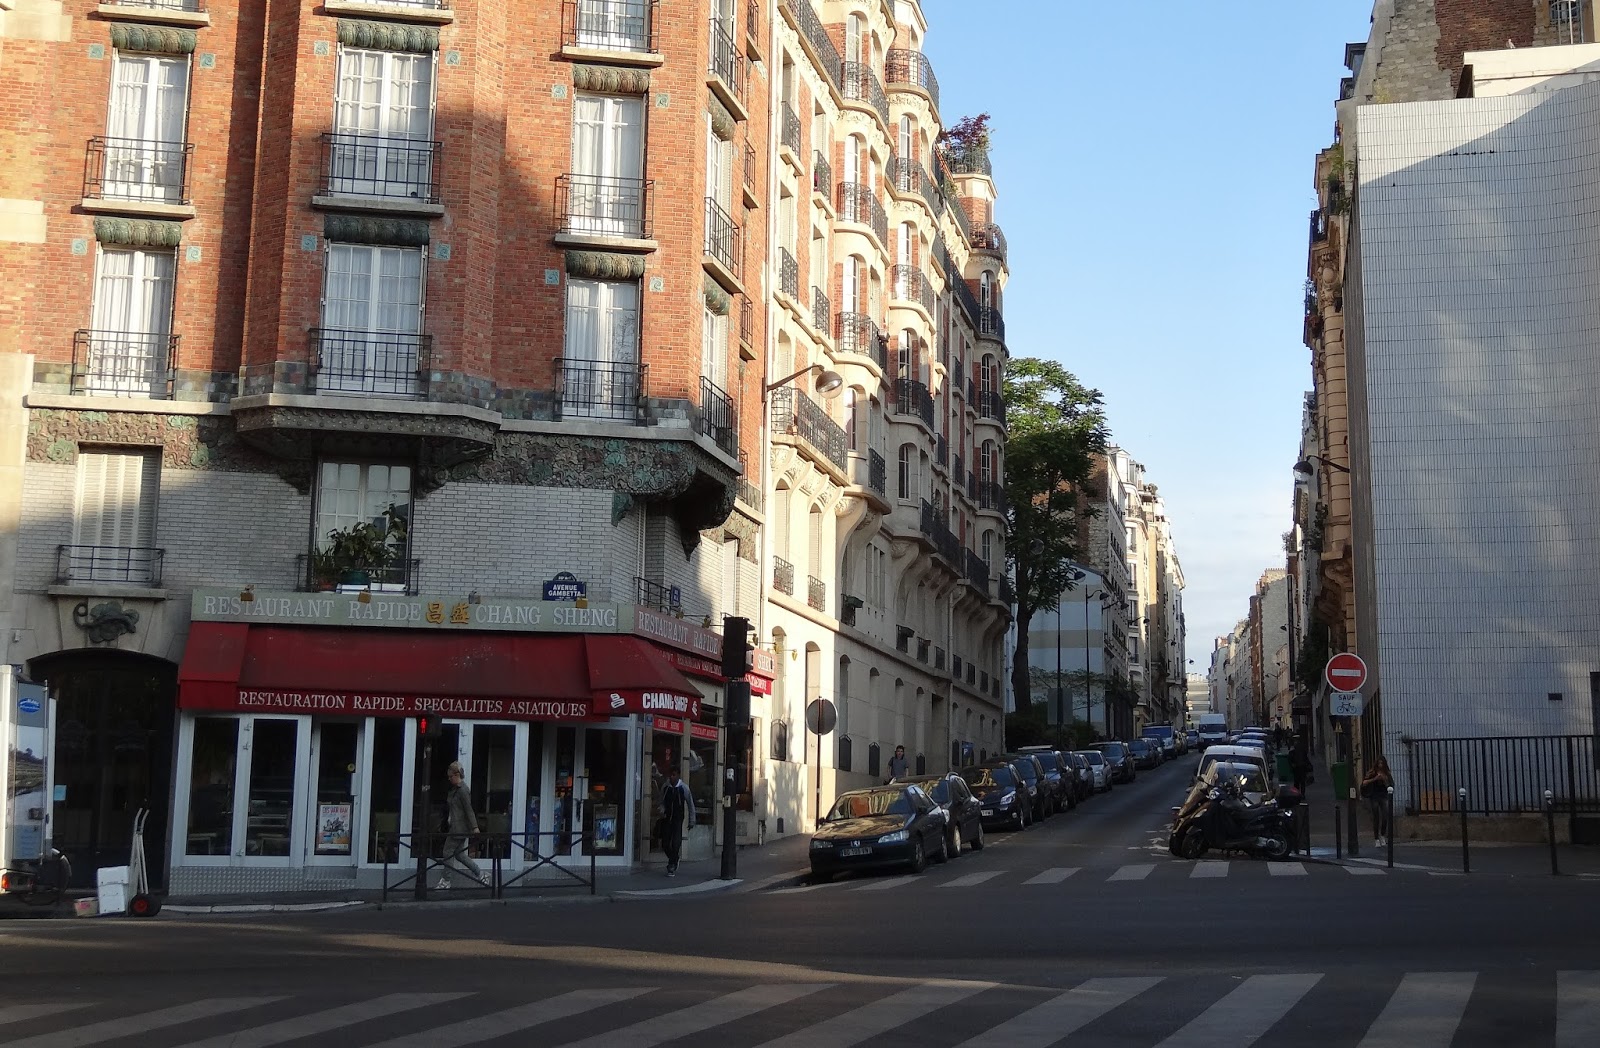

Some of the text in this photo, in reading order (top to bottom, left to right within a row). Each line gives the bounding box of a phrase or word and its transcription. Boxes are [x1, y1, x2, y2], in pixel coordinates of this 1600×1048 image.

[203, 595, 421, 621] RESTAURANT RAPIDE
[426, 602, 470, 625] 昌盛
[475, 604, 617, 627] CHANG SHENG
[638, 611, 718, 655] RESTAURANT RAPIDE
[239, 691, 347, 709] RESTAURATION
[414, 697, 503, 713] SPECIALITES
[508, 701, 587, 717] ASIATIQUES
[642, 692, 674, 710] CHANG
